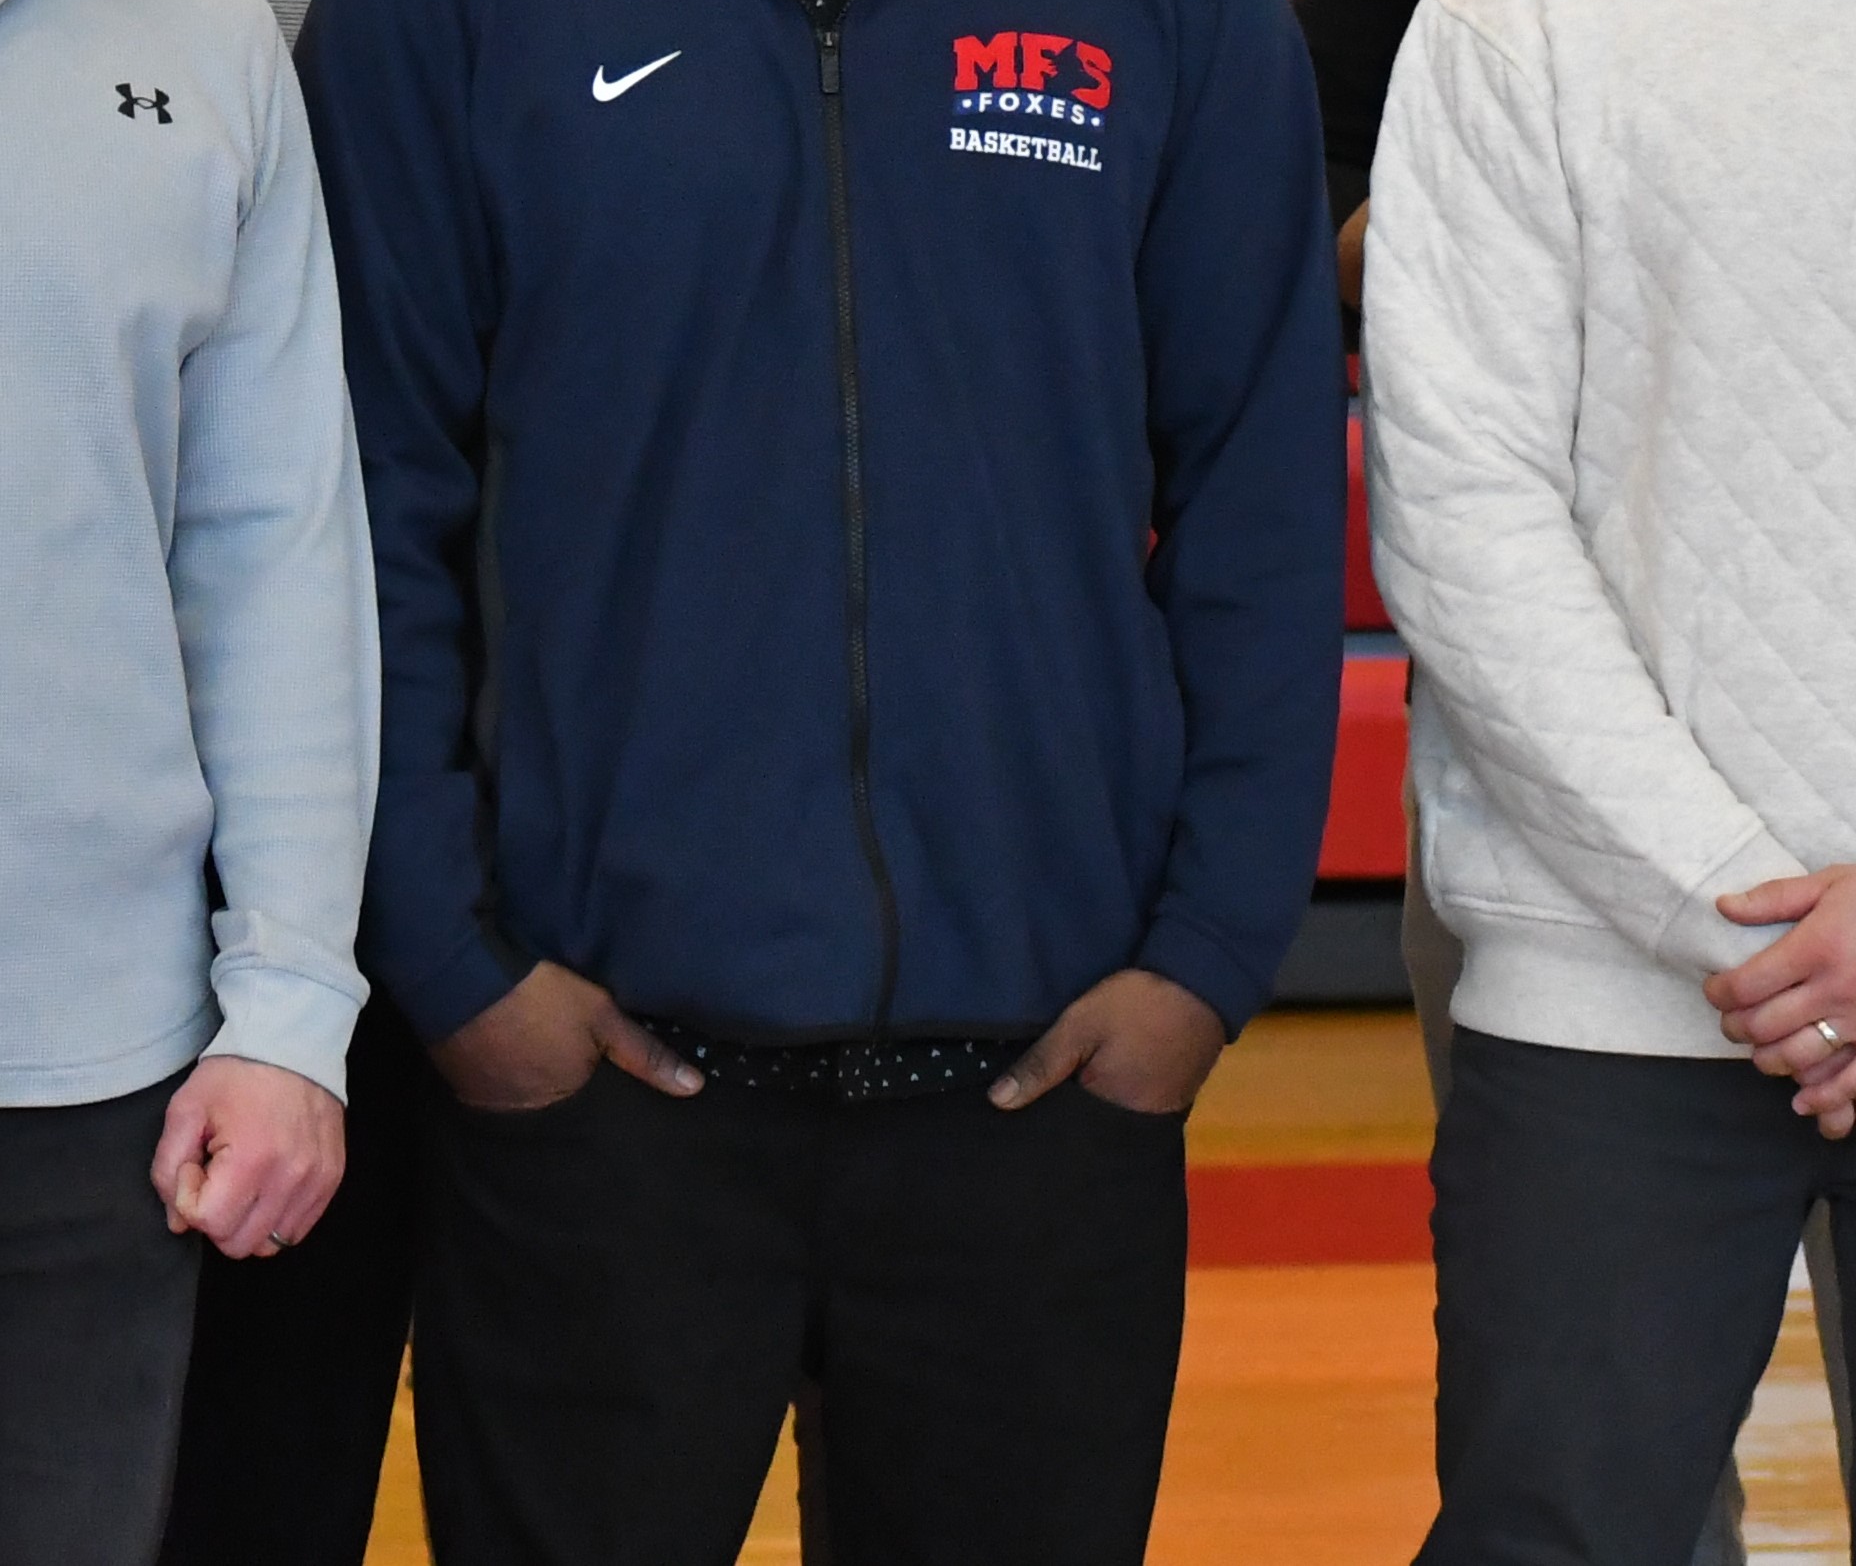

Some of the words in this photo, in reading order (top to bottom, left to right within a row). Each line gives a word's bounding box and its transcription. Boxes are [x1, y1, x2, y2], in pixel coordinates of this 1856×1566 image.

[953, 31, 1113, 109] MFS
[978, 92, 1086, 126] FOXES
[950, 127, 1103, 171] BASKETBALL
